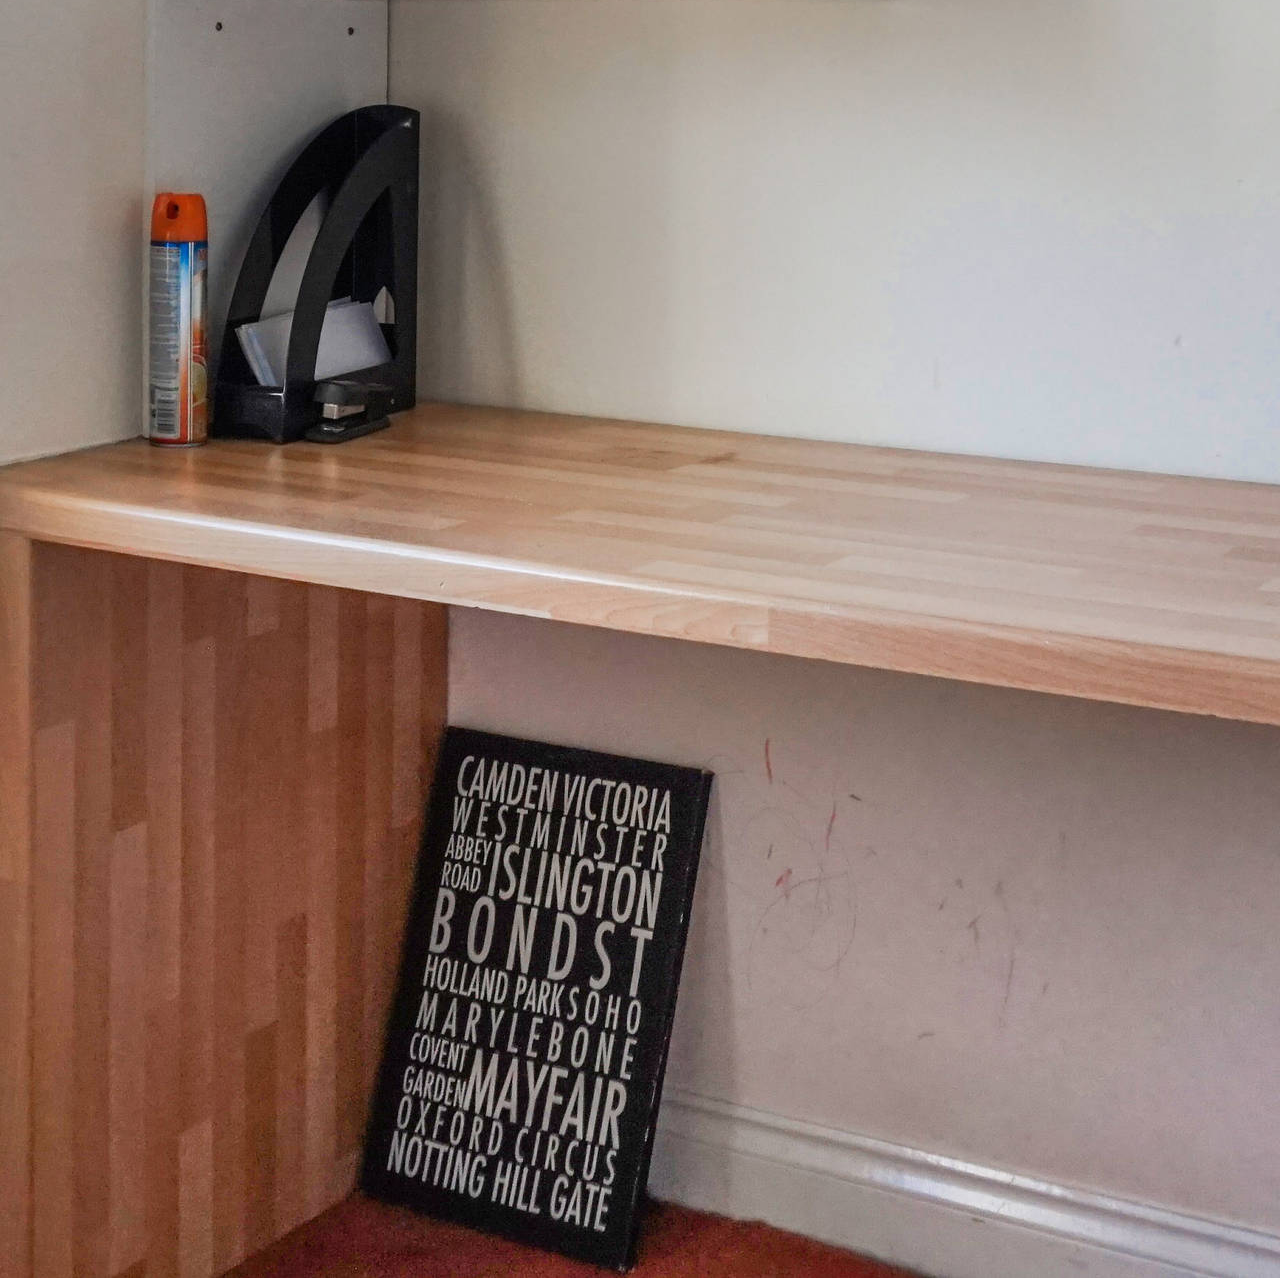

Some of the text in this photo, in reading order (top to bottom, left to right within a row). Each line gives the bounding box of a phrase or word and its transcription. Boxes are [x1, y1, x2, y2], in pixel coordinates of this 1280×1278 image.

[452, 796, 667, 872] WESTMINSTER
[457, 756, 671, 833] CAMDEN VICTORIA
[442, 861, 481, 893] ROAD
[445, 835, 489, 866] ABBEY
[488, 842, 663, 931] ISLINGTON
[429, 887, 653, 998] BOND ST
[424, 954, 641, 1035] HOLLAND PARK SOHO
[410, 1034, 469, 1071] COVENT
[416, 992, 637, 1080] MARYLEBONE
[403, 1066, 466, 1108] GARDEN
[465, 1048, 627, 1149] MAYFAIR
[387, 1130, 612, 1232] NOTTING HILL GATE
[397, 1096, 616, 1185] OXFORD CIRCUS
